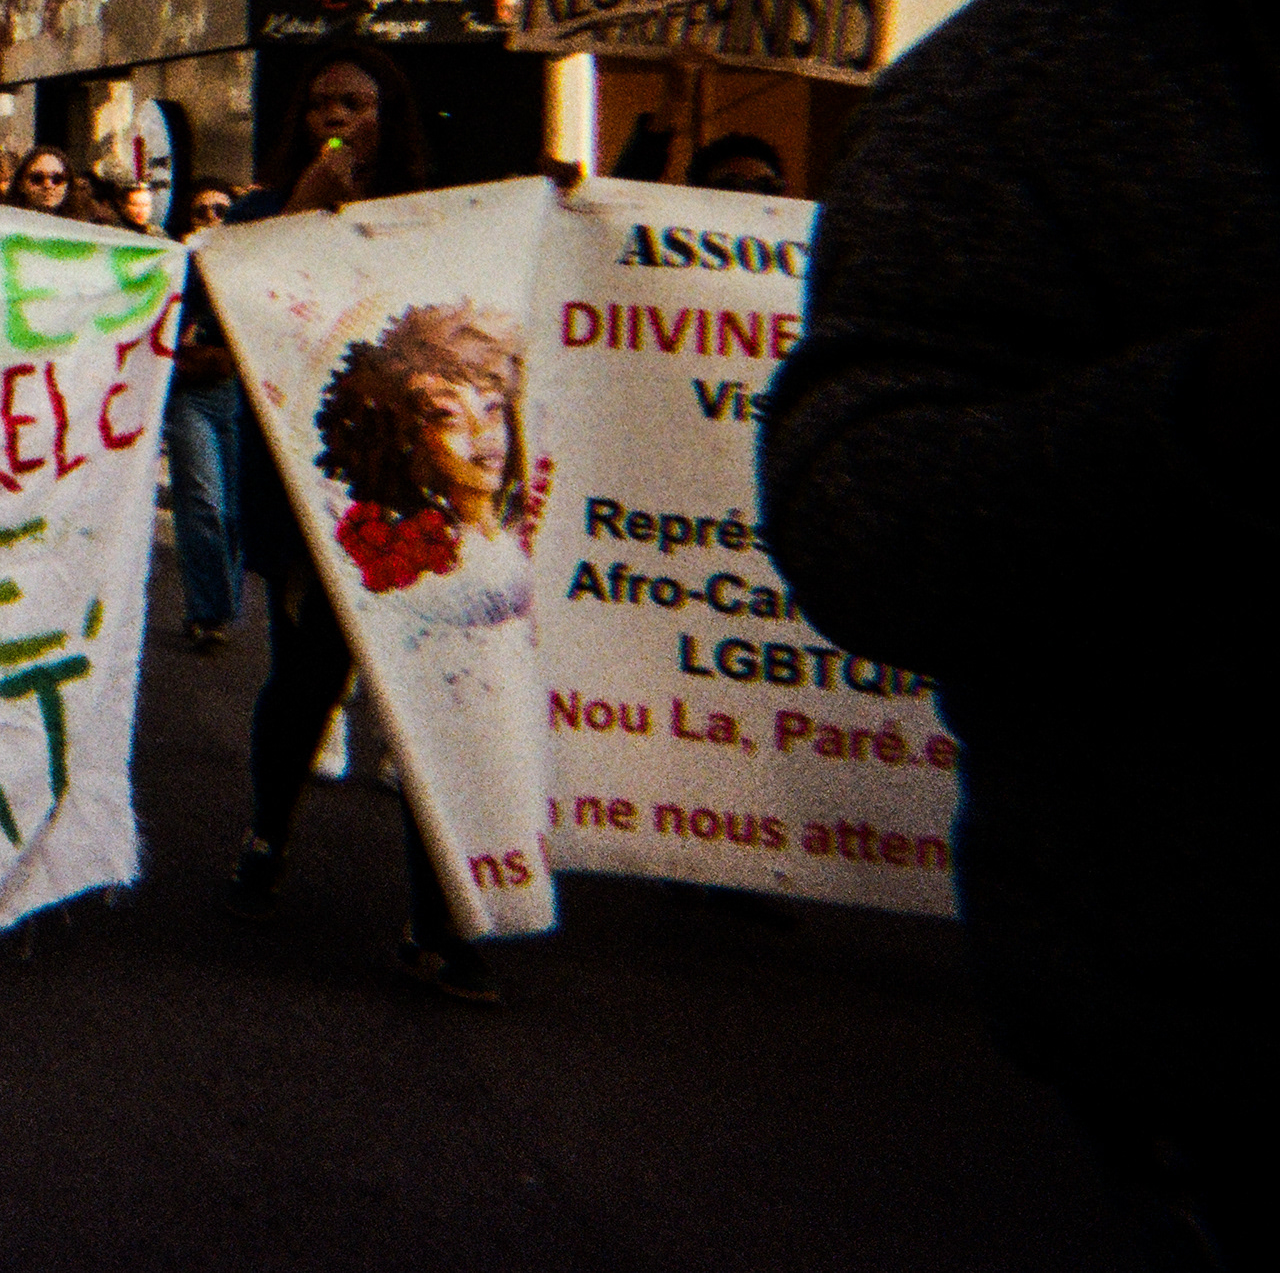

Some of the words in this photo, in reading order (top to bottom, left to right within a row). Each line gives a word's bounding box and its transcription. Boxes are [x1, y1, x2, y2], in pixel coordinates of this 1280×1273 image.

[548, 690, 651, 735] Nou
[669, 698, 755, 753] La,
[574, 795, 633, 829] ne
[652, 801, 787, 851] nous
